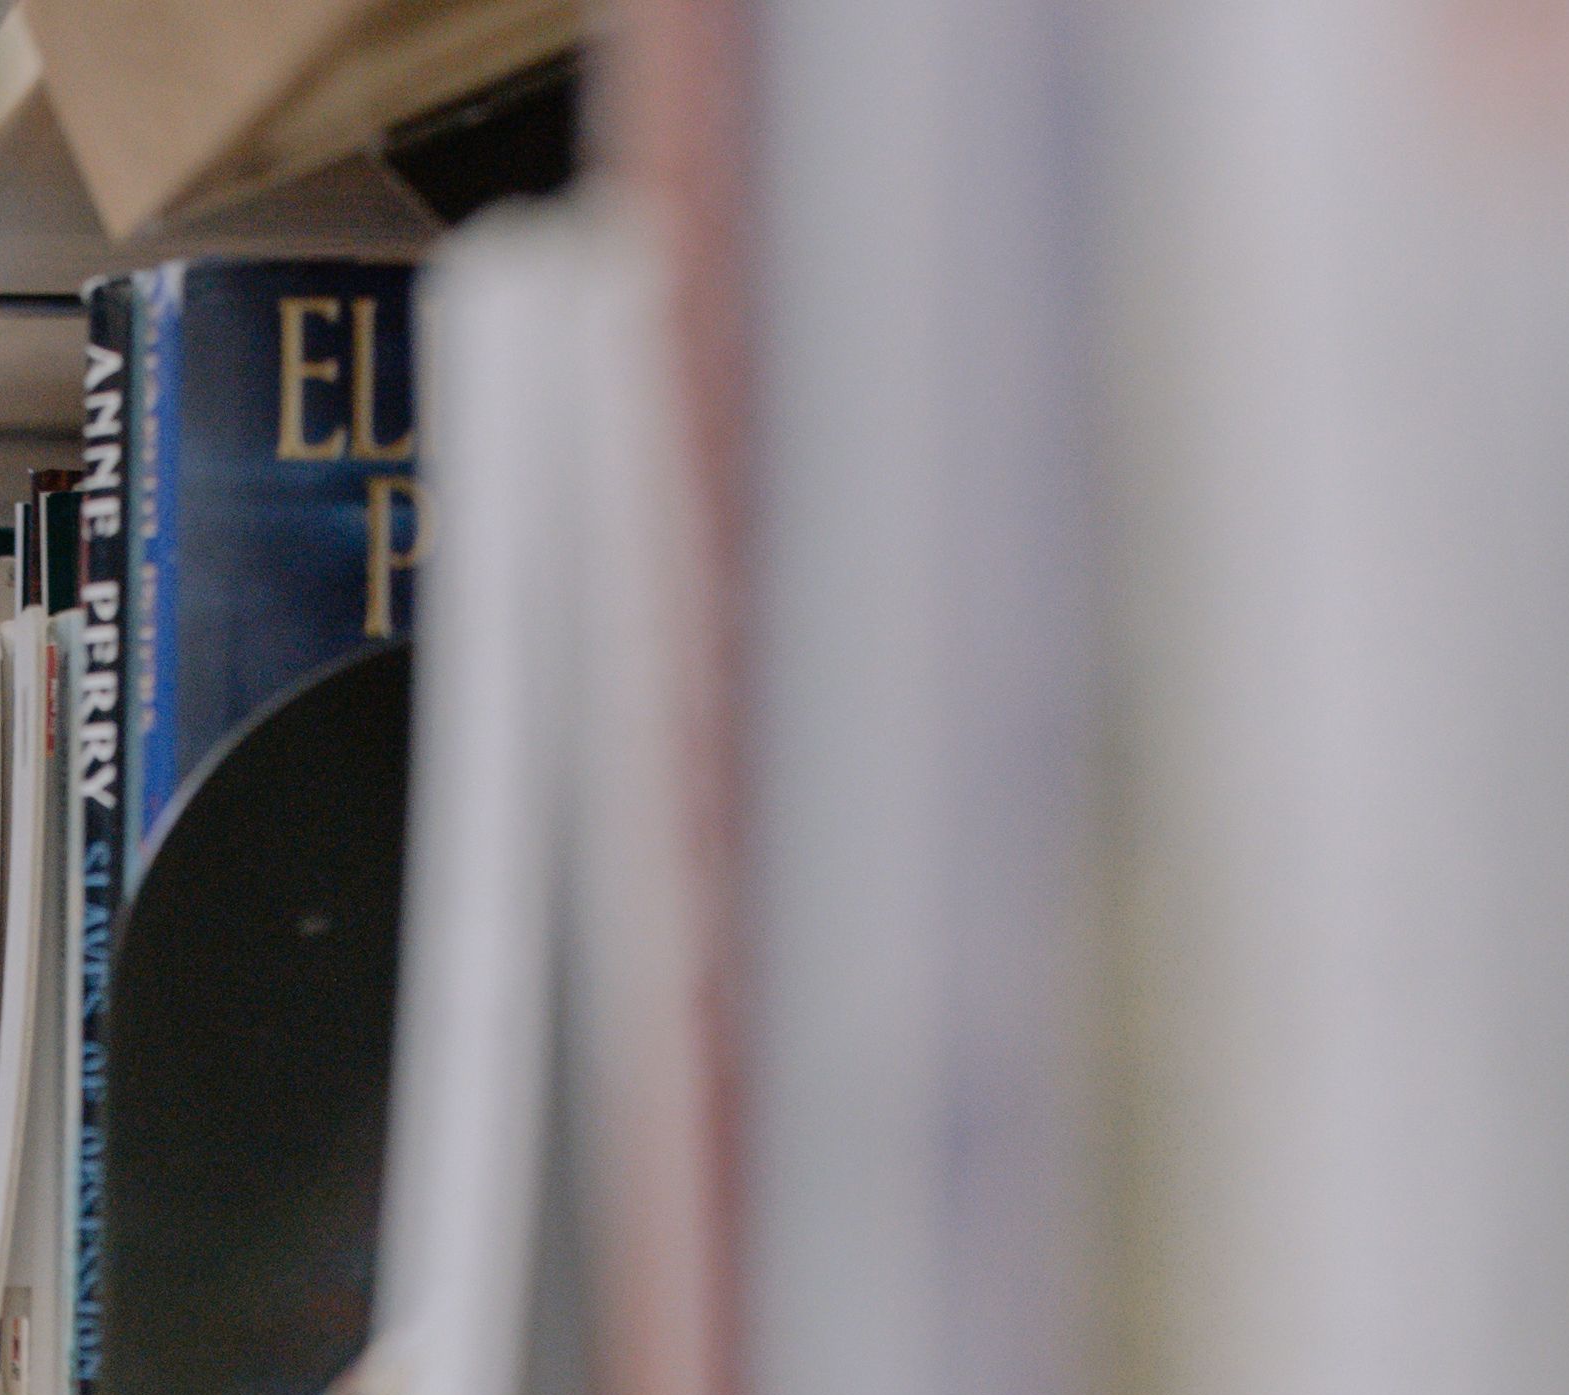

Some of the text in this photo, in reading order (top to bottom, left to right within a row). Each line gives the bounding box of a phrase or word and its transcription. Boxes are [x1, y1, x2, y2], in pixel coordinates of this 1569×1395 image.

[276, 296, 418, 462] EL
[79, 343, 124, 812] ANNE PERRY
